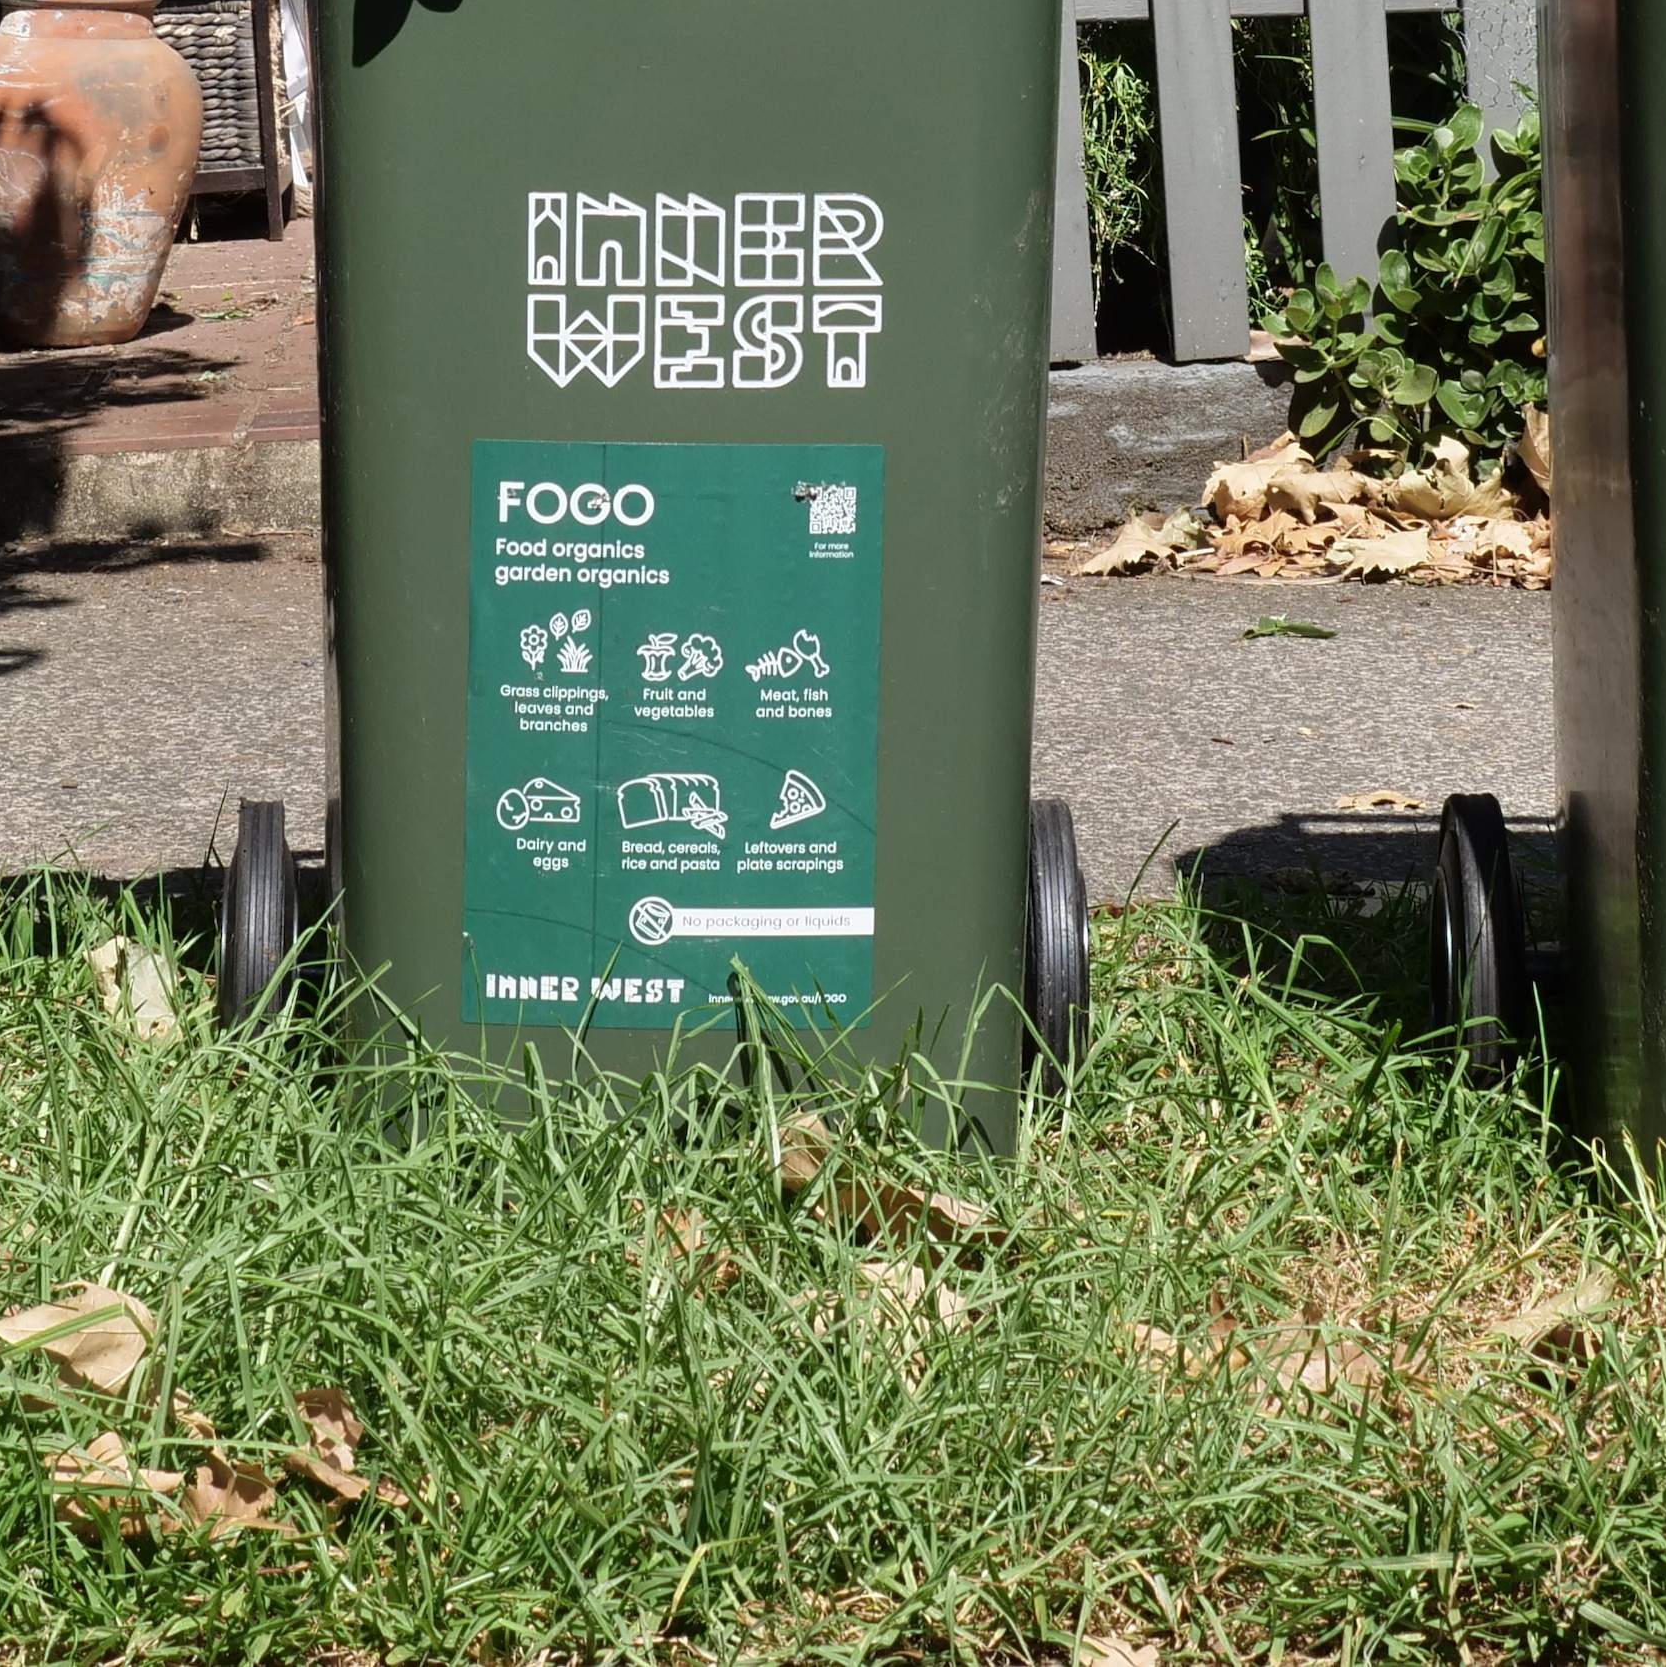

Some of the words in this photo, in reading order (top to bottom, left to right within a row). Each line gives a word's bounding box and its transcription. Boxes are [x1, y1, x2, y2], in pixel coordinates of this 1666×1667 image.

[528, 192, 883, 287] INNER
[527, 294, 882, 389] WEST
[498, 481, 654, 526] FOGO
[496, 538, 546, 557] Food
[552, 541, 645, 562] organics
[495, 564, 571, 585] garden
[577, 565, 670, 588] organics
[500, 684, 539, 699] Grass
[543, 686, 609, 704] clippings,
[643, 688, 674, 702] Fruit
[677, 688, 706, 702] and
[760, 688, 800, 704] Meat,
[802, 688, 828, 702] fish
[514, 701, 561, 715] leaves
[564, 702, 593, 716] and
[634, 705, 714, 720] vegetables
[756, 705, 785, 718] and
[788, 705, 832, 719] bones
[520, 718, 587, 733] branches
[517, 838, 553, 855] Dairy
[557, 838, 586, 852] and
[622, 840, 665, 856] Bread,
[668, 841, 721, 856] cereals,
[745, 841, 805, 855] Leftovers
[808, 841, 837, 855] and
[533, 856, 569, 872] eggs
[621, 856, 647, 871] rice
[650, 856, 677, 871] and
[680, 857, 721, 874] pasta
[737, 857, 772, 874] plate
[776, 857, 844, 874] scrapings
[682, 915, 702, 928] No
[706, 915, 781, 930] packaging
[787, 917, 801, 928] or
[804, 914, 851, 931] liquids
[486, 974, 580, 1002] INNER
[590, 976, 685, 1004] WEST
